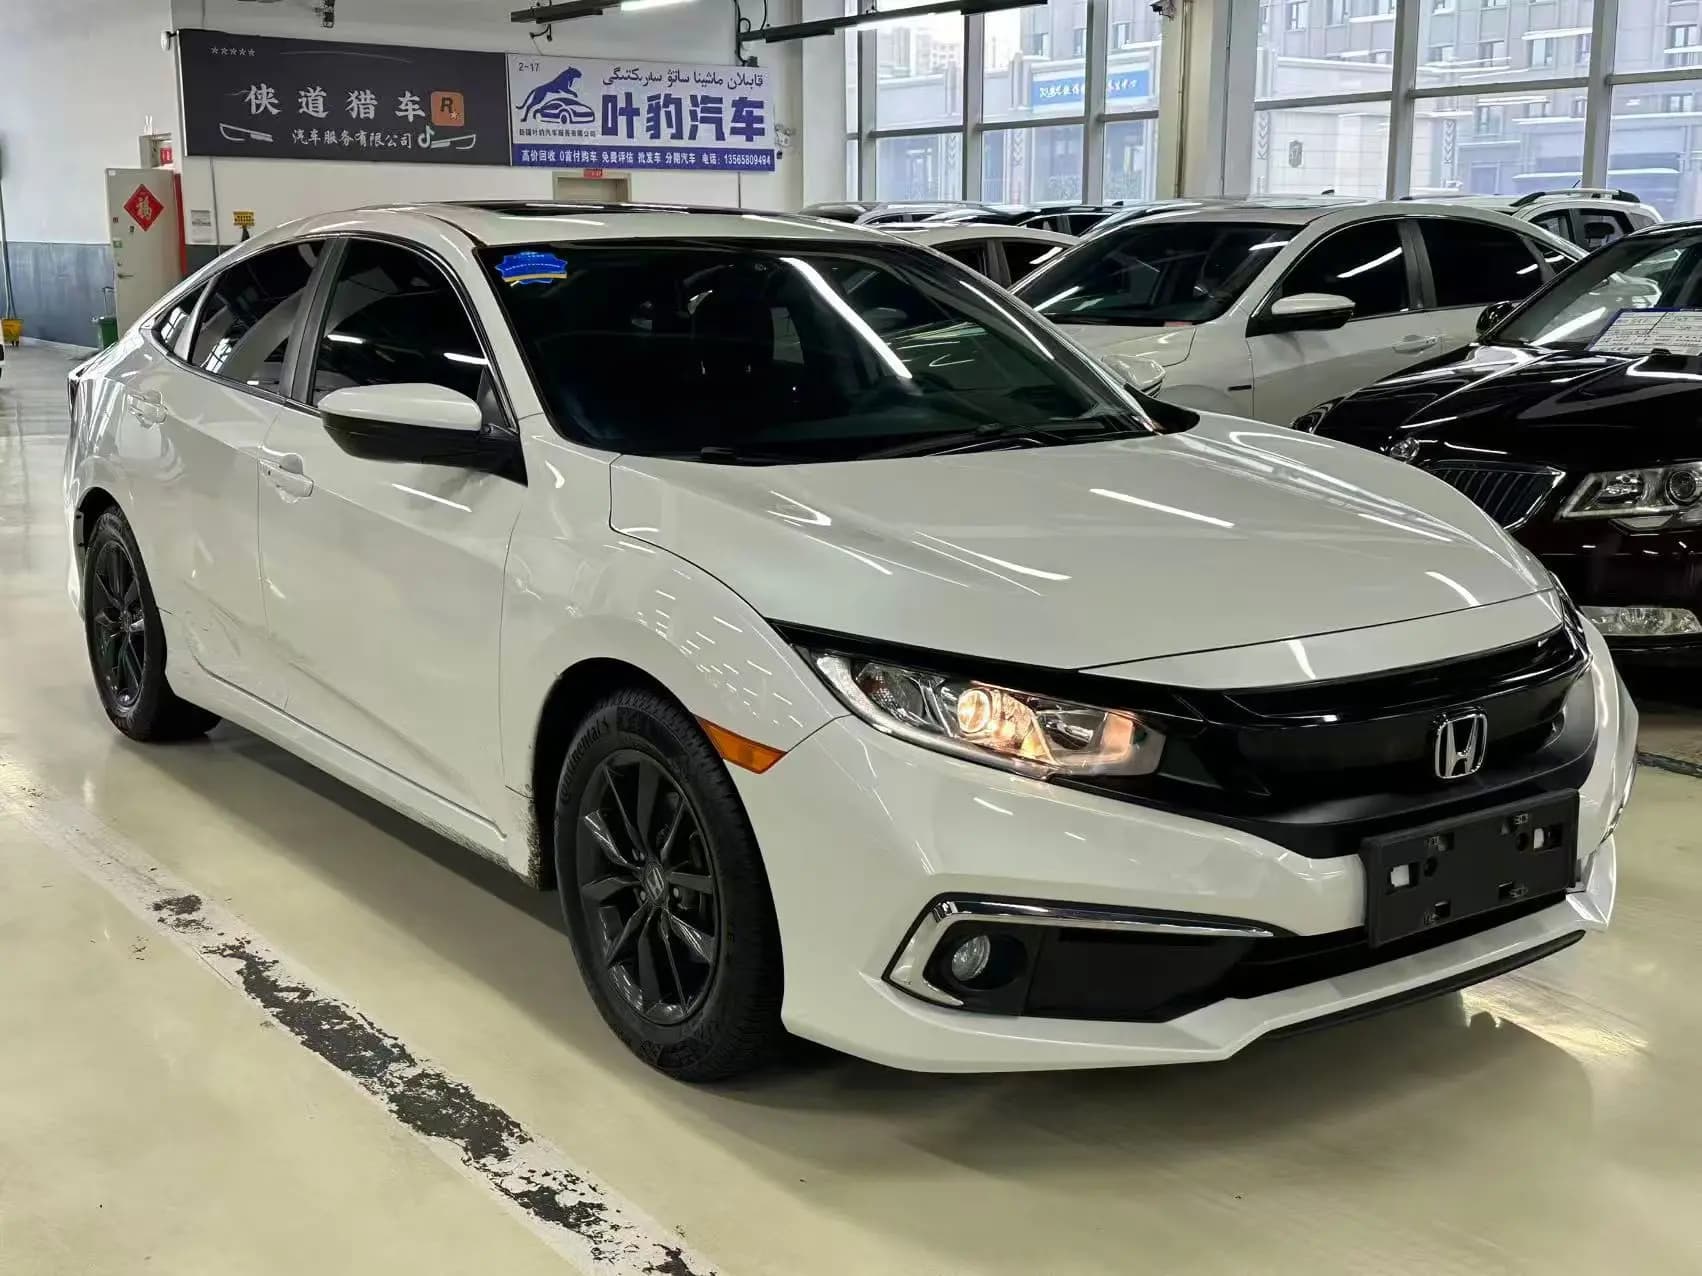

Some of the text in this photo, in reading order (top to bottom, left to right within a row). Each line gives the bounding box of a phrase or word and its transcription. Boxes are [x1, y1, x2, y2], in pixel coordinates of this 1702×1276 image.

[518, 62, 540, 73] 2-17
[244, 83, 426, 122] 侠道猎车
[602, 92, 765, 142] 叶豹汽车
[292, 128, 412, 149] 汽车服务有限公司
[521, 150, 556, 161] 高价回收
[601, 152, 634, 163] 免费评估
